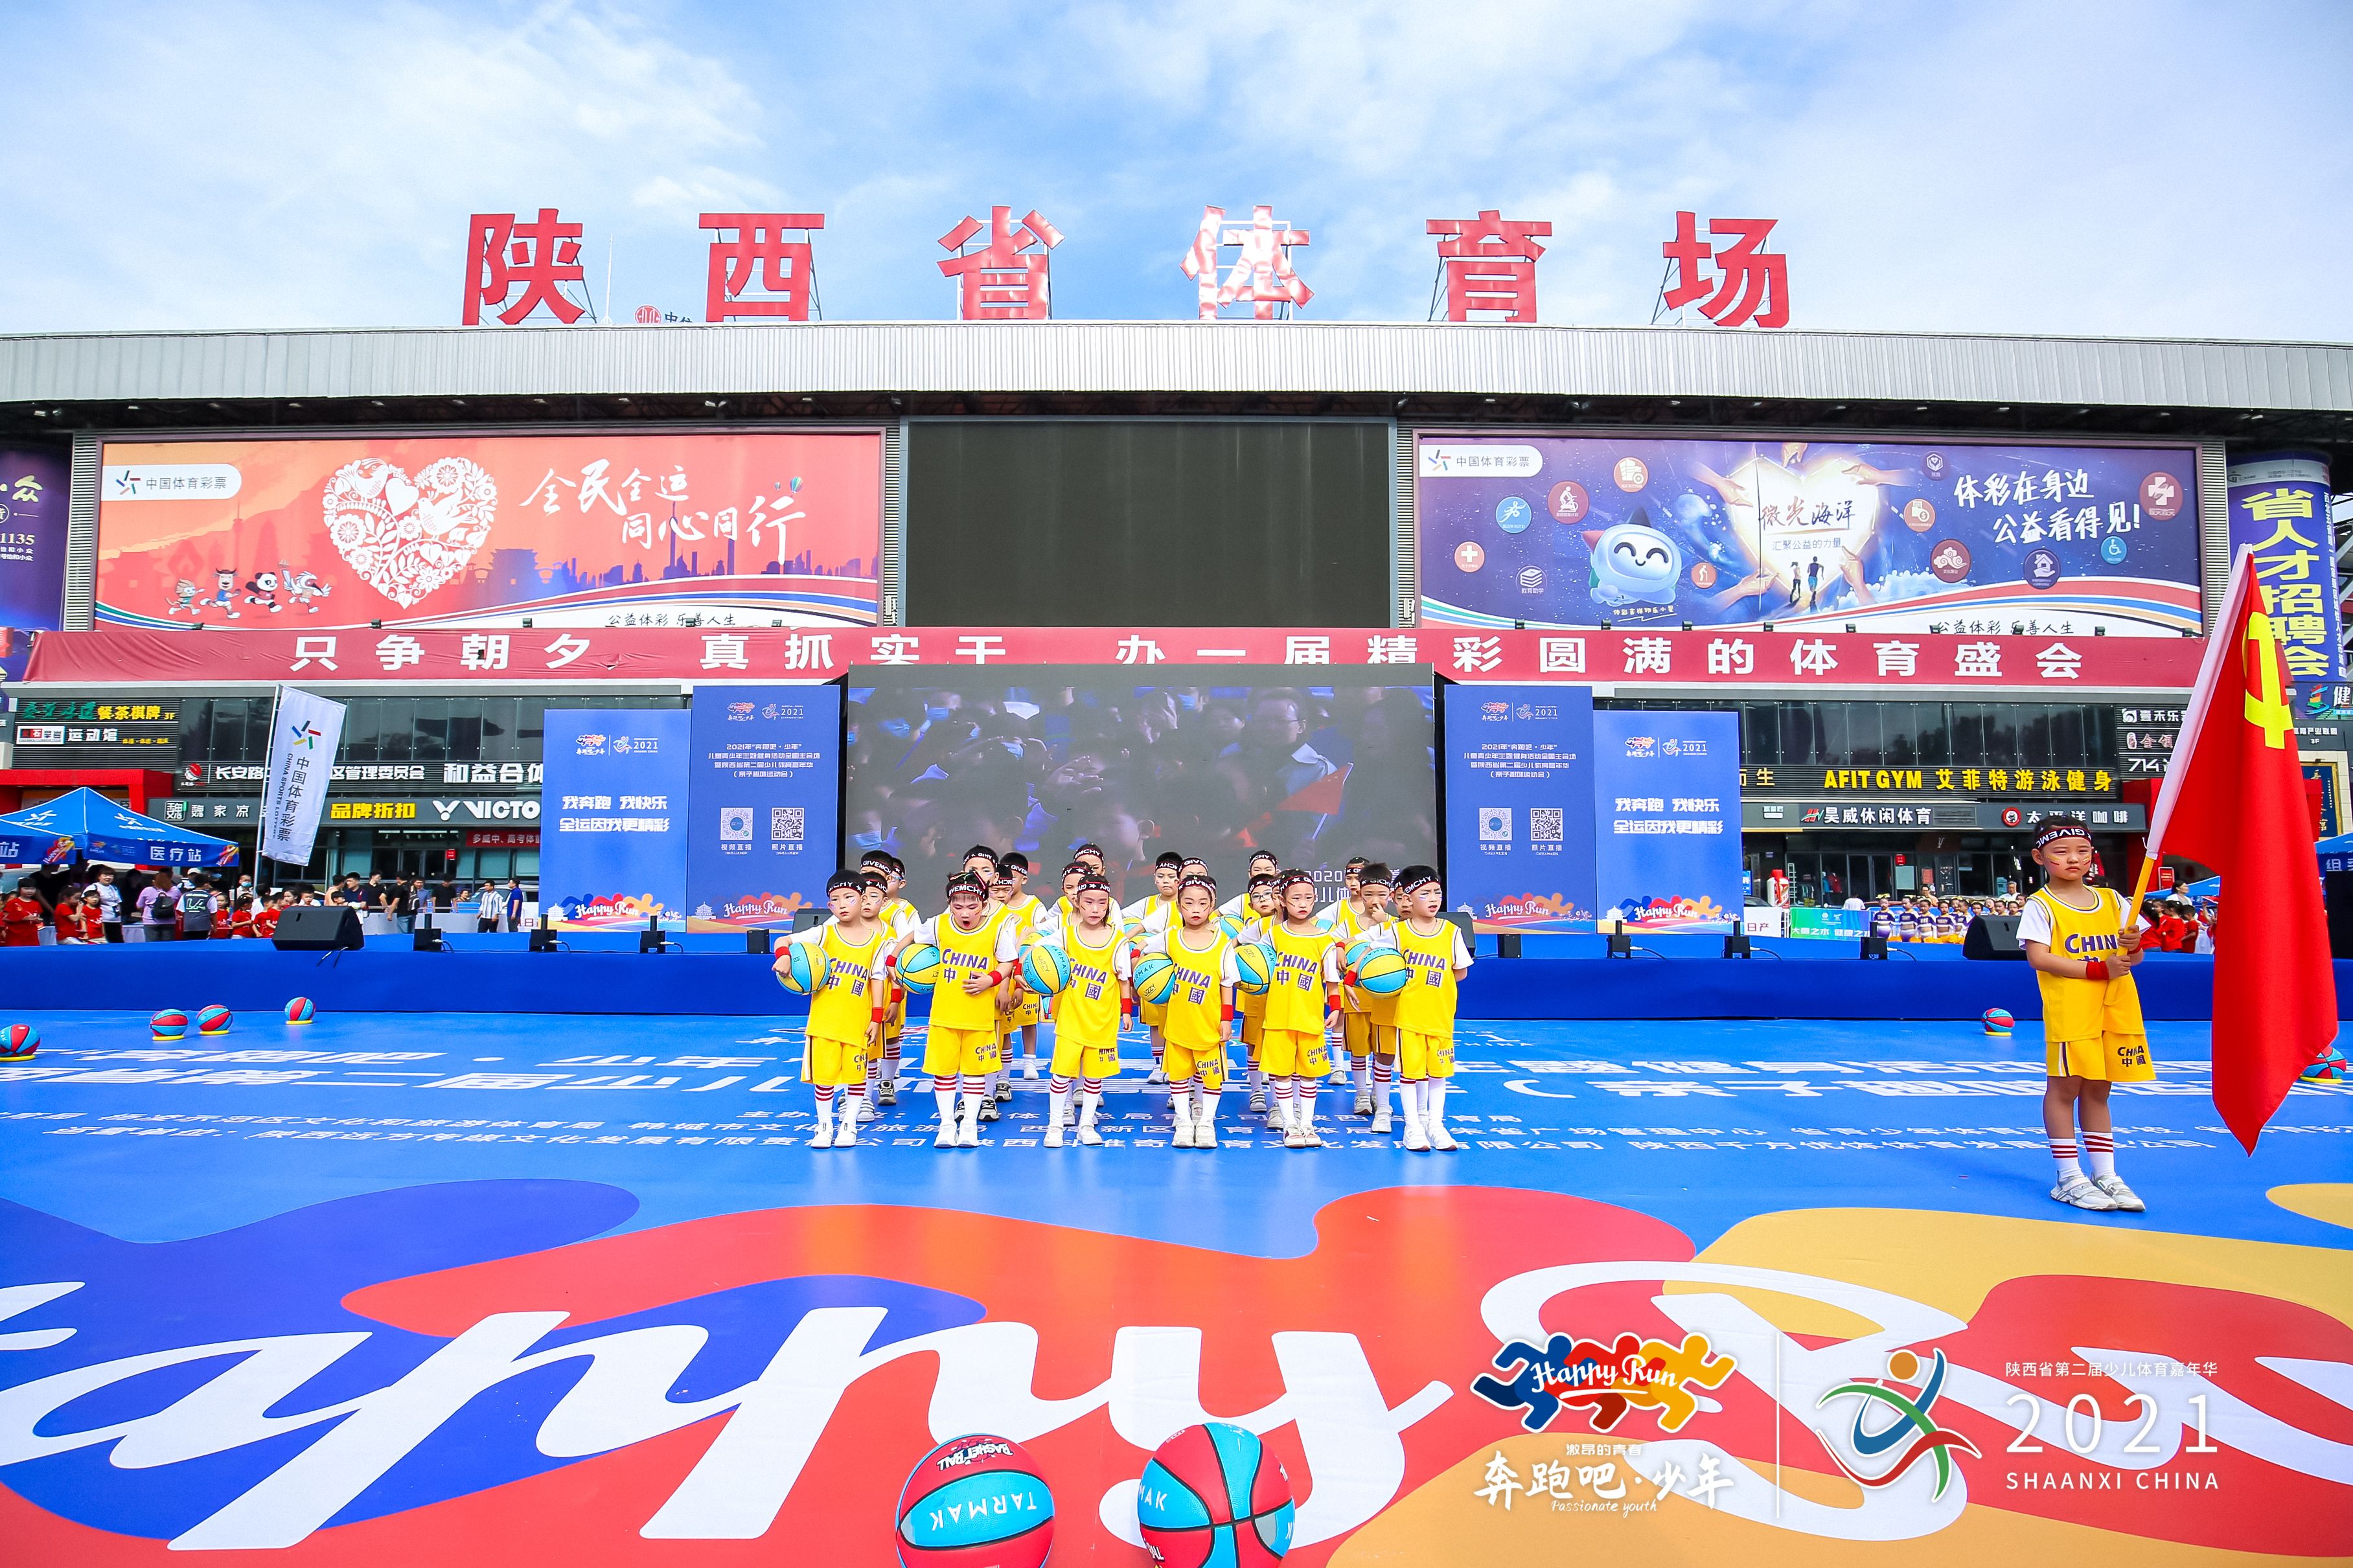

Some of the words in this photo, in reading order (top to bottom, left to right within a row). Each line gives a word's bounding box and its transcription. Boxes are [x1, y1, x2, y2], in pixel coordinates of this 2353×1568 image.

[462, 205, 1789, 327] 陕西省体育场
[1456, 455, 1530, 468] 中国体育彩票
[146, 476, 227, 490] 中国体育彩票
[520, 458, 689, 517] 全民全运
[1954, 468, 2094, 508] 体彩在身边
[1758, 495, 1855, 527] 微光海洋
[621, 495, 806, 565] 同心同行
[1772, 538, 1842, 551] 汇聚公益的力量
[2241, 488, 2329, 677] 省人才招聘会
[609, 614, 668, 626] 公益体彩
[1938, 619, 2001, 635] 公益体彩
[290, 633, 590, 672] 只争朝夕
[699, 633, 1006, 670] 真抓实干
[1115, 634, 2083, 677] 办一届精彩圆满的体育盛会
[97, 705, 161, 720] 餐茶棋牌
[67, 728, 118, 742] 运动馆
[1682, 744, 1708, 752] 2021
[283, 753, 293, 775] CHINA
[2128, 758, 2170, 772] 714
[1824, 769, 1870, 788] AFIT
[1876, 769, 1922, 788] GYM
[1935, 769, 2112, 791] 艾菲特游泳健身
[277, 777, 287, 805] SPORTS
[277, 756, 310, 841] 中国体育彩票
[331, 802, 417, 819] 品牌折扣
[463, 801, 540, 819] VICTO
[562, 795, 611, 810] 我奔跑
[619, 795, 667, 810] 我快乐
[1615, 798, 1664, 812] 我奔跑
[1672, 798, 1719, 812] 我快乐
[1824, 806, 1932, 824] 昊威休闲体育
[559, 817, 670, 832] 全运因我更精彩
[1614, 820, 1723, 834] 全运因我更精彩
[0, 842, 19, 858] 站
[150, 845, 201, 863] 医疗站
[575, 904, 614, 919] Happy
[615, 902, 639, 916] Run
[723, 902, 762, 917] Happy
[763, 900, 788, 915] Run
[1485, 903, 1523, 918] Happy
[1524, 900, 1550, 916] Run
[1633, 905, 1672, 921] Happy
[1673, 903, 1699, 918] Run
[1747, 922, 1769, 932] 日产
[2064, 933, 2120, 954] CHIN
[942, 948, 987, 969] CHINA
[1276, 970, 1313, 992] 中國
[975, 1043, 997, 1054] CHINA
[978, 1050, 996, 1062] 中國
[1196, 1058, 1218, 1069] CHINA
[2121, 1054, 2146, 1067] 中國
[1200, 1065, 1221, 1077] 中國
[930, 1491, 1038, 1532] TARMAK
